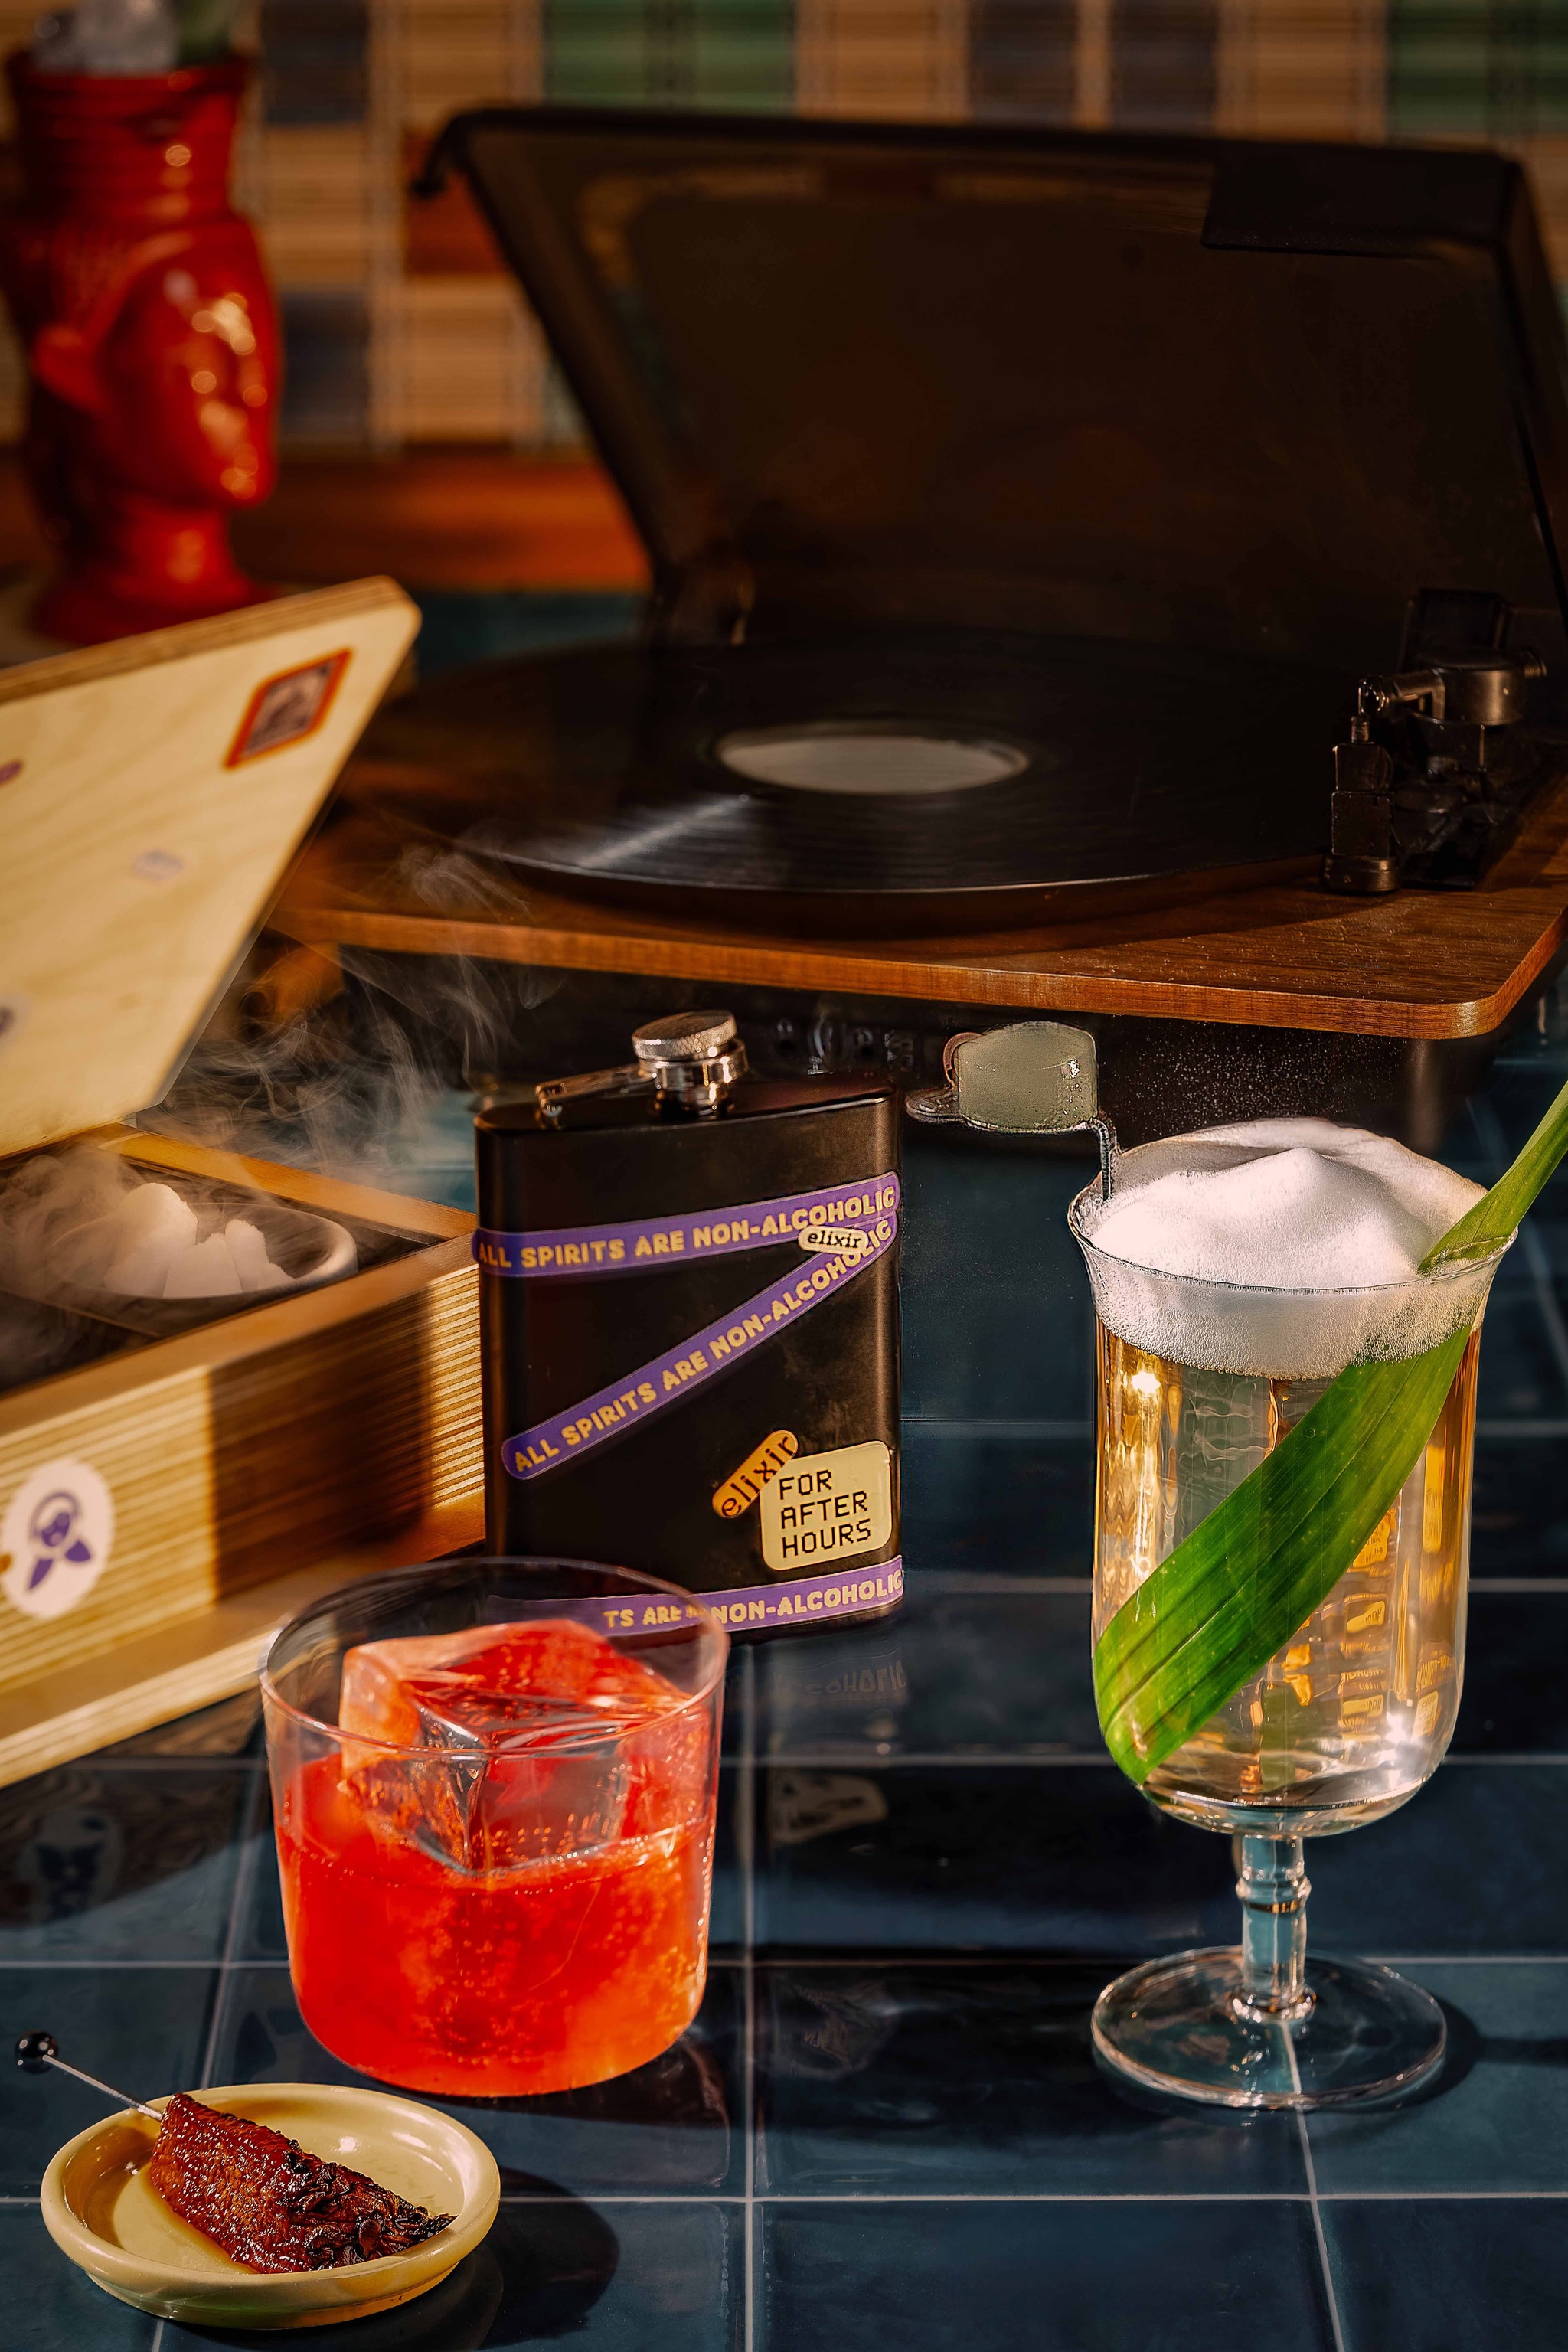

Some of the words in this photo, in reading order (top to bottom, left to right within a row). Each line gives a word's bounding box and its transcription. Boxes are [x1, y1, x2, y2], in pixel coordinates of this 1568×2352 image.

[479, 1242, 511, 1268] ALL
[521, 1238, 626, 1268] SPIRITS
[635, 1230, 684, 1257] ARE
[692, 1186, 895, 1249] NON-ALCOHOLIC
[808, 1230, 861, 1249] elixir
[514, 1439, 560, 1472] ALL
[561, 1382, 657, 1446] SPIRITS
[662, 1350, 709, 1391] ARE
[721, 1436, 795, 1517] elixir
[779, 1469, 832, 1500] FOR
[781, 1491, 867, 1529] AFTER
[782, 1518, 871, 1558] HOURS
[642, 1605, 682, 1626] ARE
